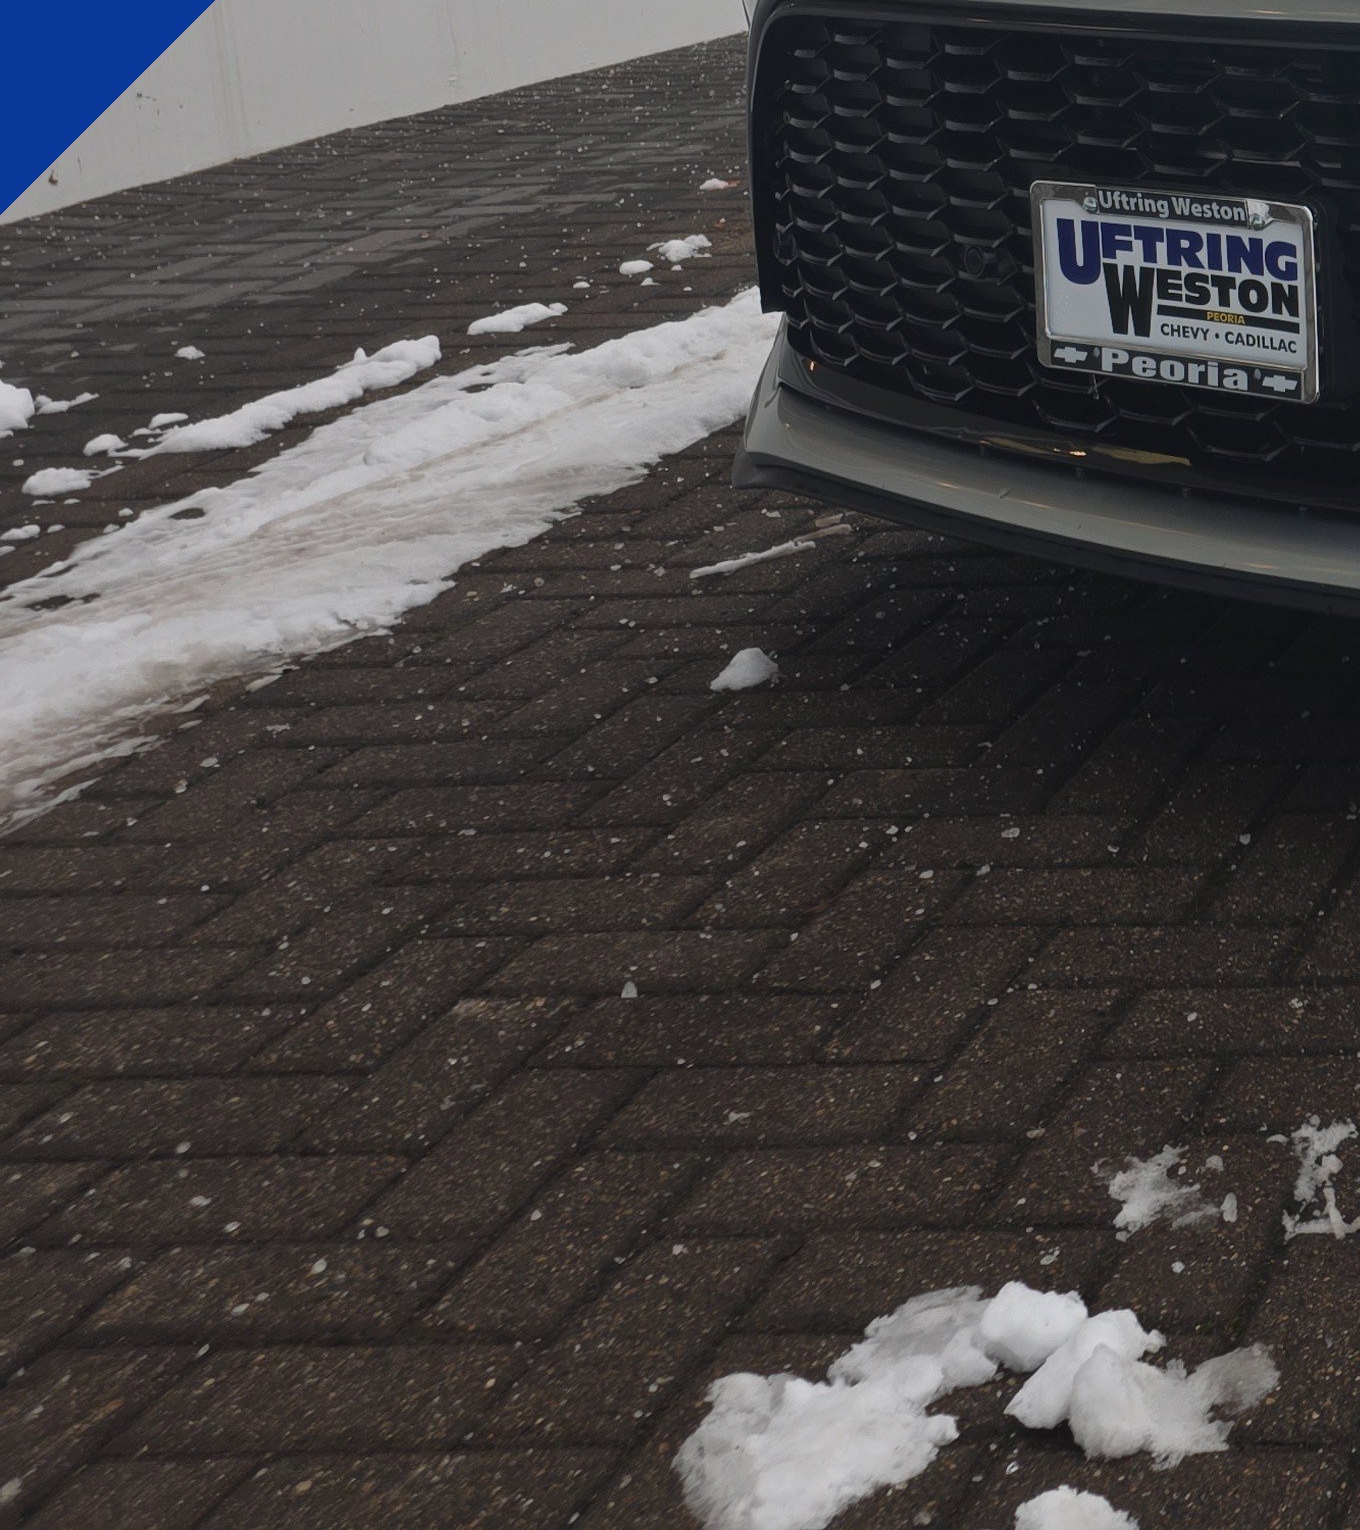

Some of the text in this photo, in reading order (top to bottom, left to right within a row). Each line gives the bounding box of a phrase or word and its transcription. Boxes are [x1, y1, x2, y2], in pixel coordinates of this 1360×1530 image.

[1099, 190, 1246, 221] Uftring Weston
[1056, 217, 1299, 285] UFTRING
[1102, 262, 1300, 338] WESTON
[1206, 311, 1246, 325] PEORIA
[1160, 323, 1298, 354] CHEVY CADILLAC
[1101, 348, 1249, 391] Peoria
